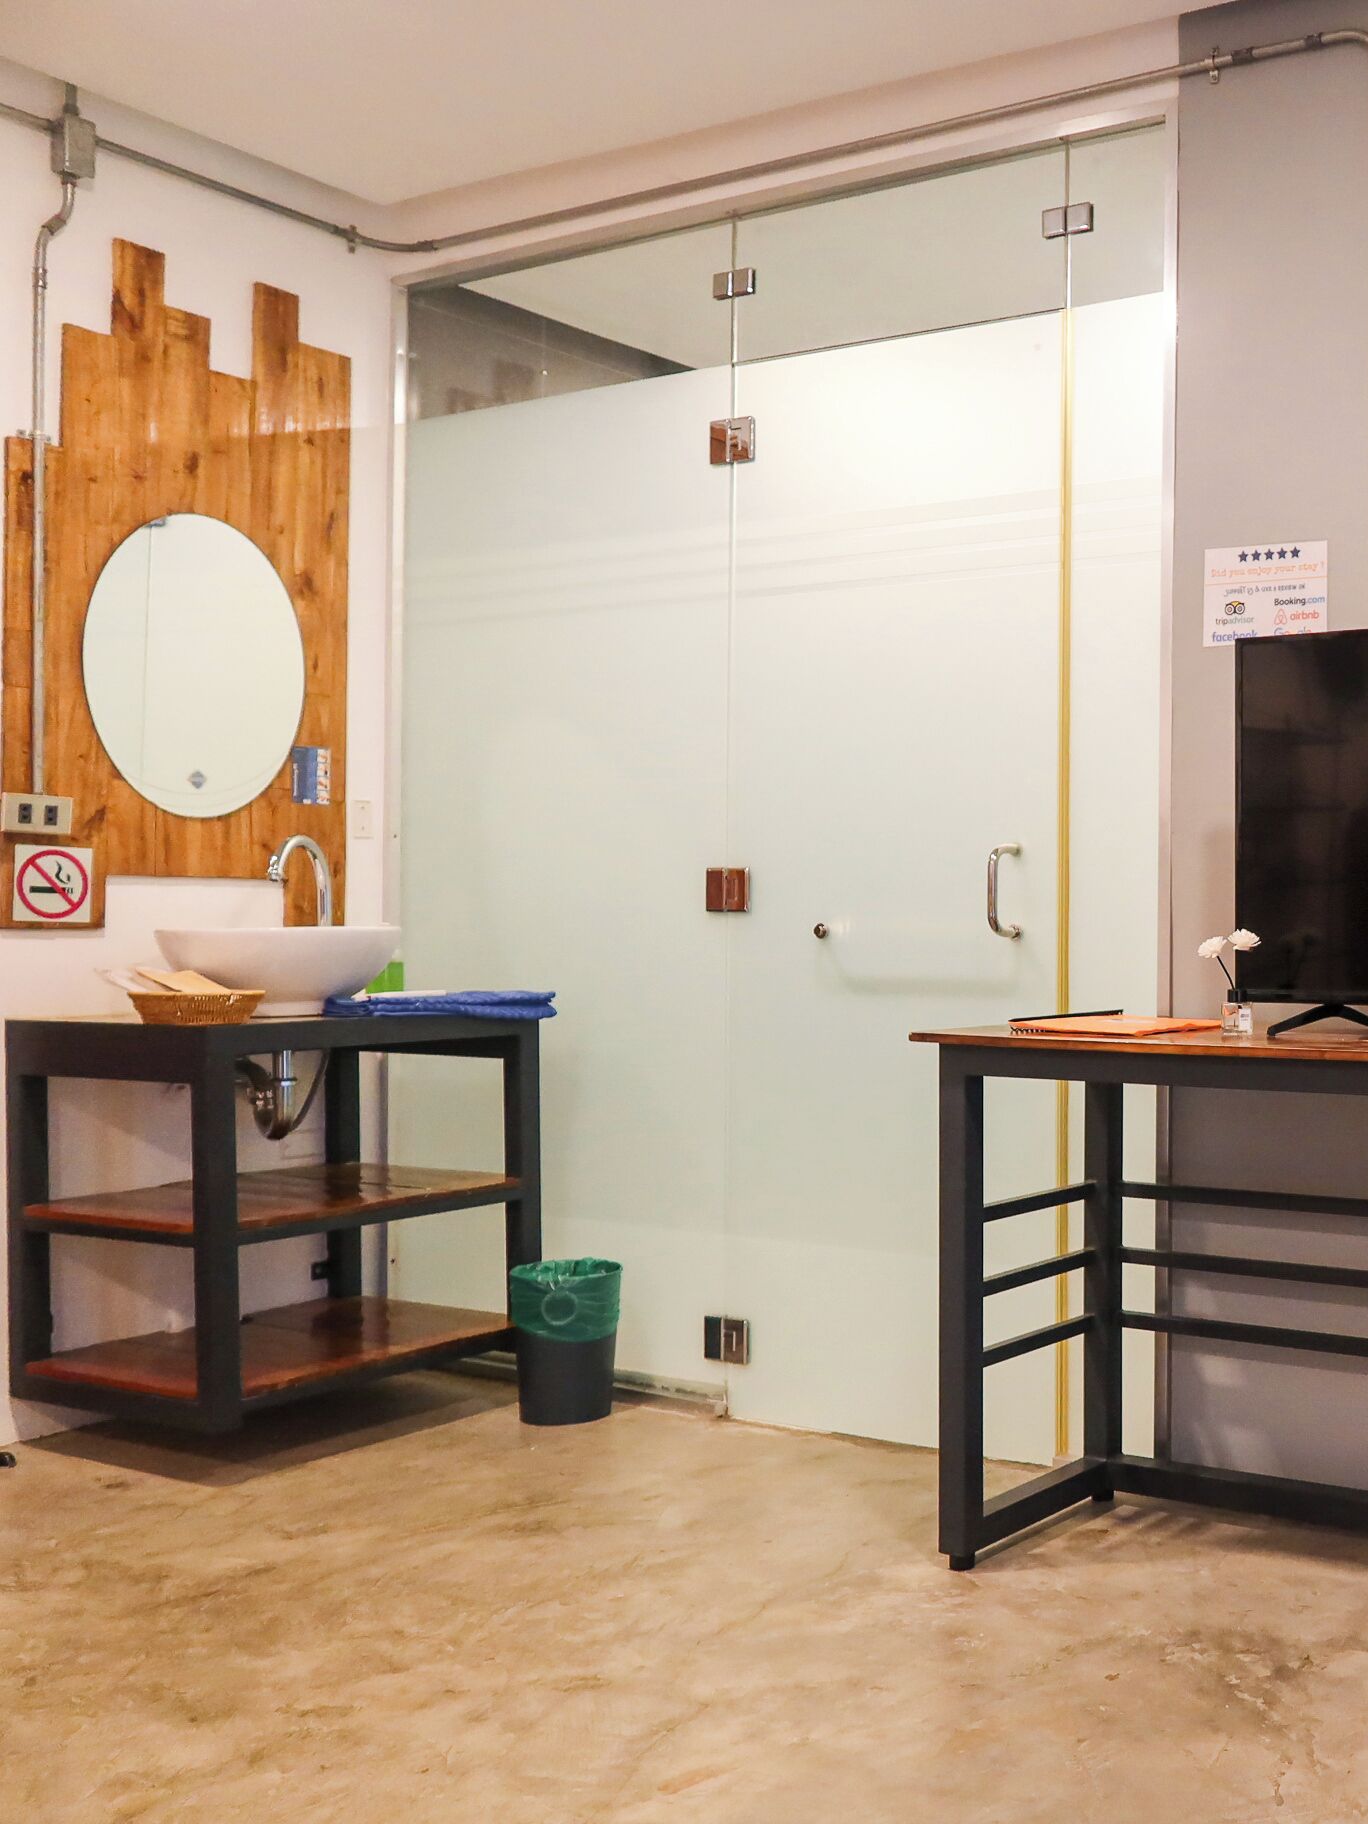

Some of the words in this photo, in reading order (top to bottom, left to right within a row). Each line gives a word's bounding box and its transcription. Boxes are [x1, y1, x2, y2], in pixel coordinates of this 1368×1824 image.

[1229, 569, 1245, 578] you
[1247, 566, 1273, 576] enjoy
[1274, 565, 1296, 574] your
[1298, 562, 1318, 572] stay
[1274, 597, 1325, 606] Booking.com
[1290, 610, 1319, 620] airbnb
[1215, 617, 1254, 626] tripadvisor
